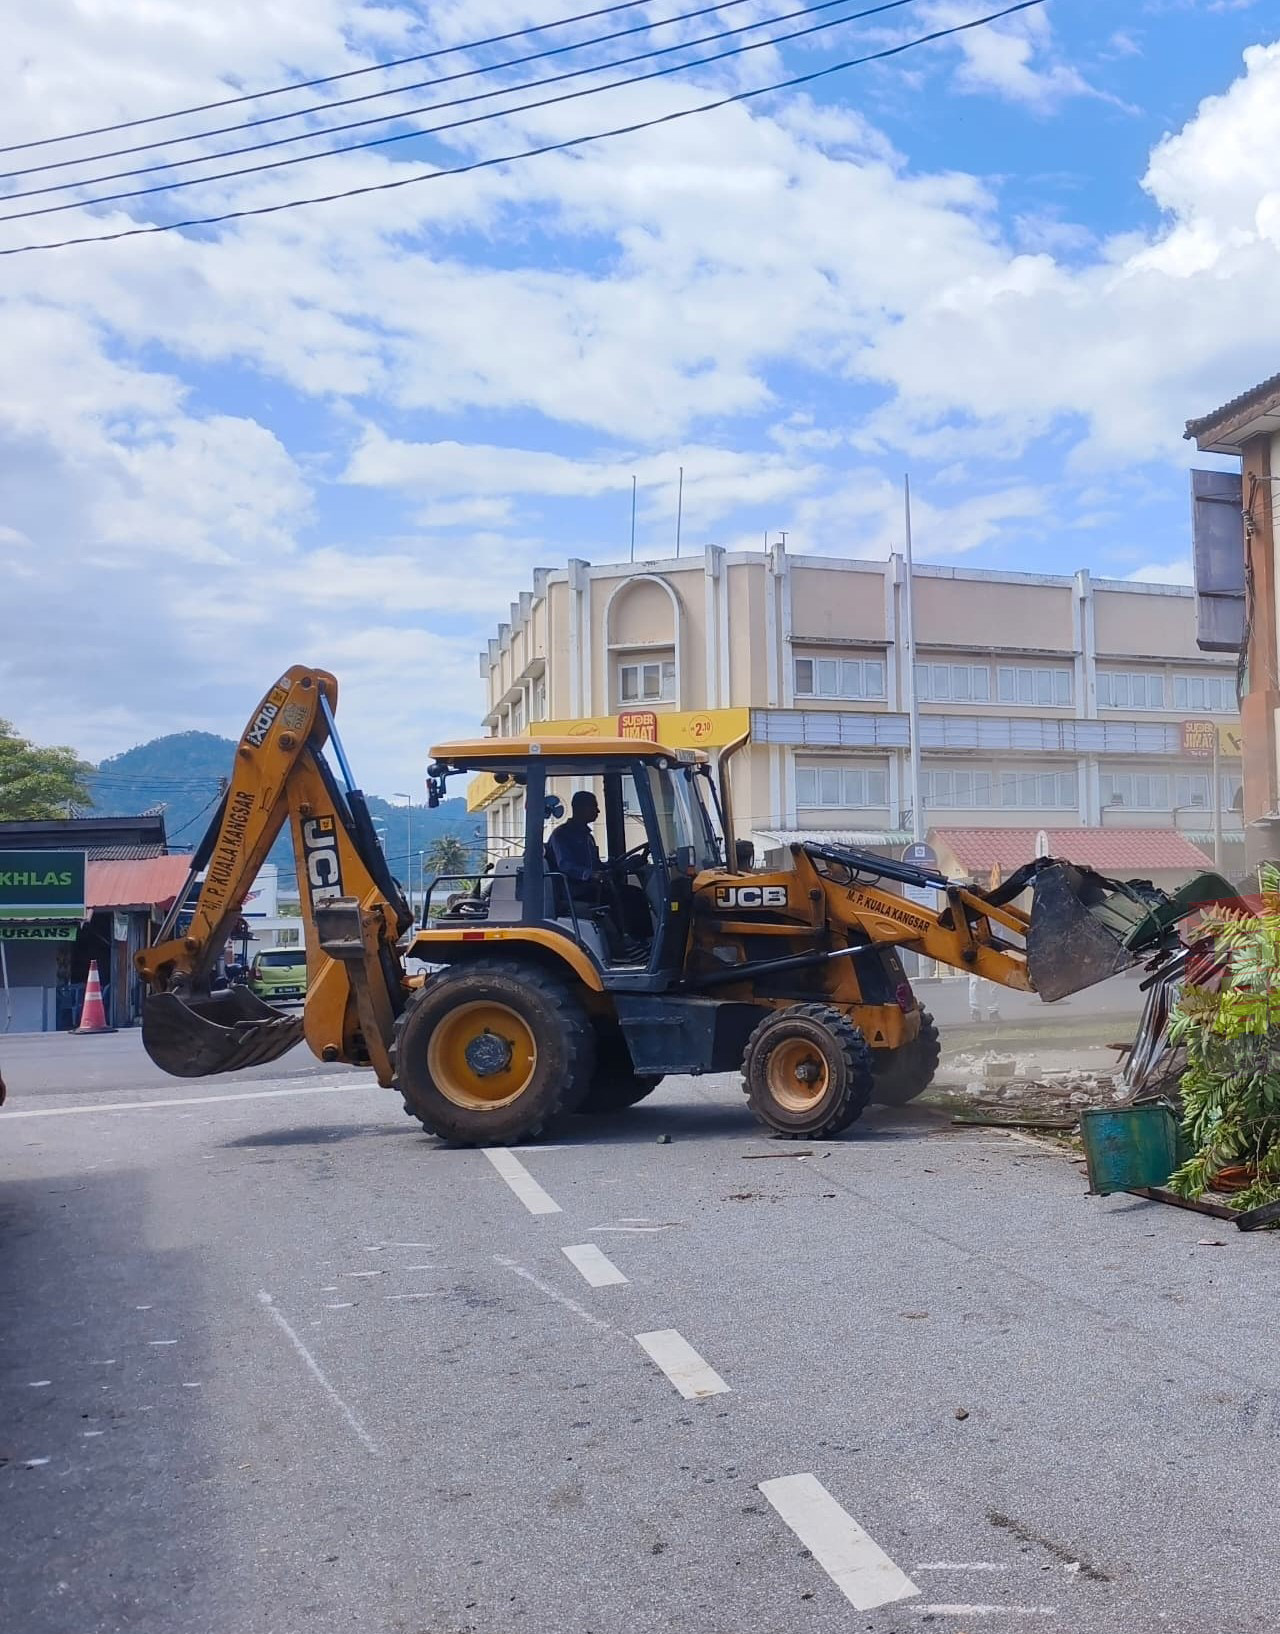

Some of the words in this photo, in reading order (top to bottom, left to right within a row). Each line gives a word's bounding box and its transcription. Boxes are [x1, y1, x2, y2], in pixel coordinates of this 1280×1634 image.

[222, 791, 256, 848] KANGSAR
[210, 847, 237, 887] KUALA
[717, 886, 788, 908] JCB
[864, 897, 892, 917] KUALA
[891, 907, 930, 933] KANGSAR
